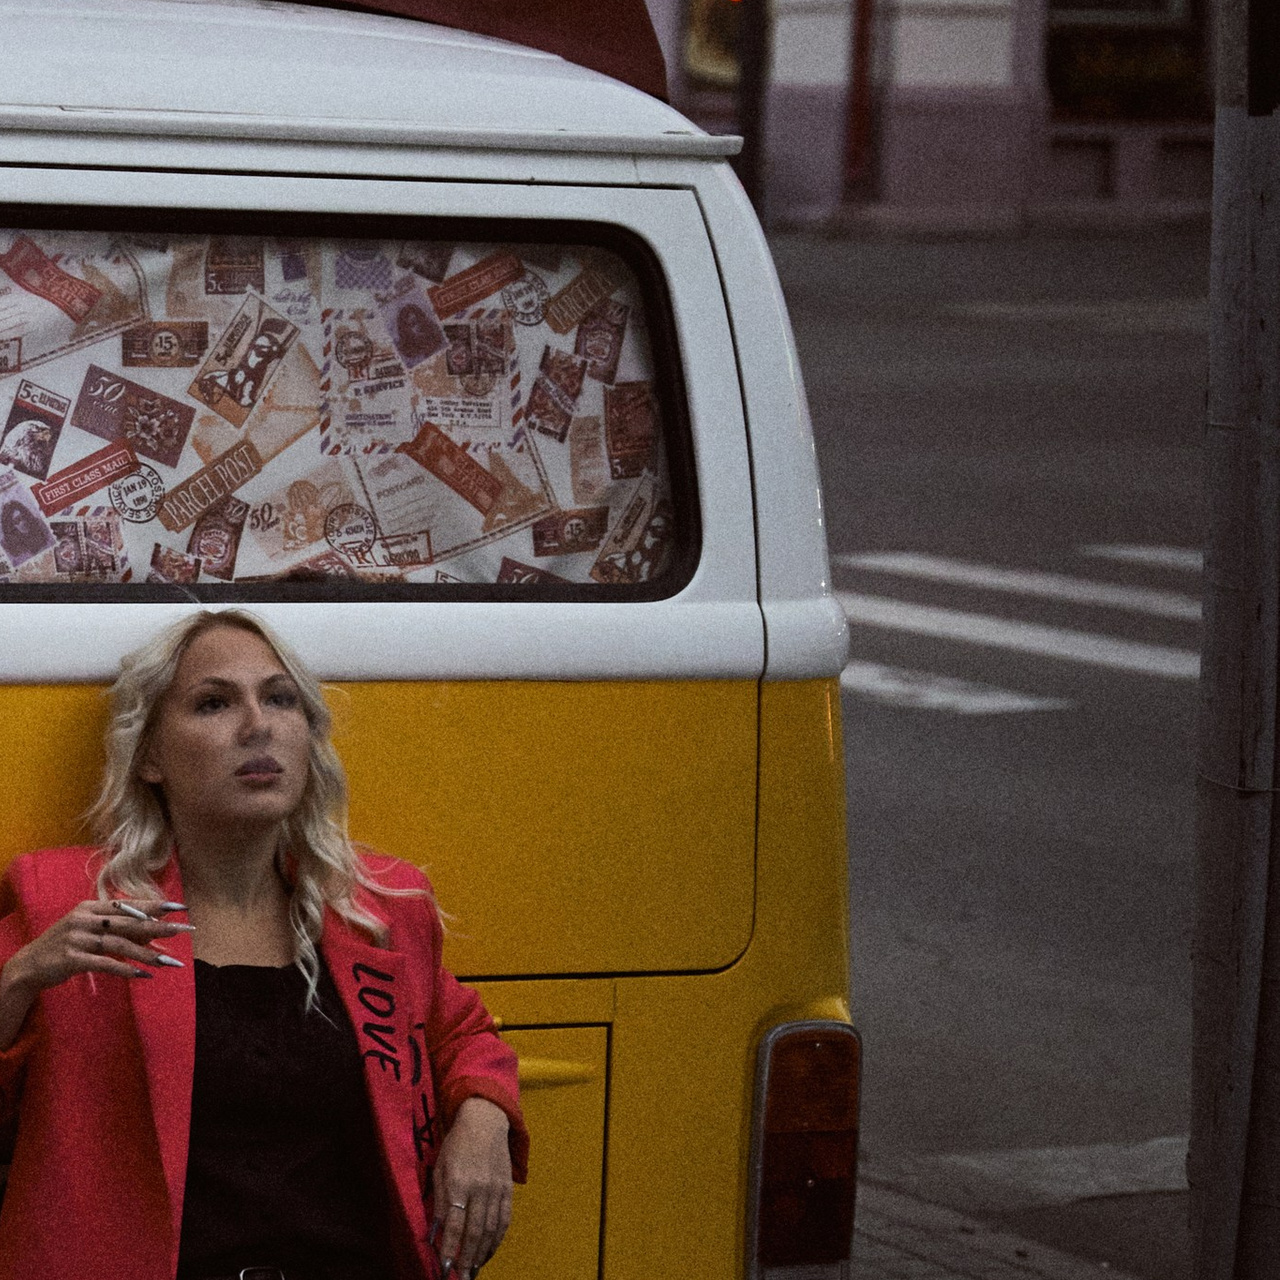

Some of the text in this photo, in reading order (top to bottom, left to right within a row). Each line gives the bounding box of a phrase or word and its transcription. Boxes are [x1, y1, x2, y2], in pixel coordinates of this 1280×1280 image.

[158, 336, 173, 351] 15
[19, 383, 39, 403] 5c
[88, 376, 126, 403] 50
[44, 457, 129, 502] FIRST CLASS MAIL
[163, 444, 257, 528] PARCEL POST
[376, 475, 426, 500] POSTCARD
[112, 483, 142, 519] SERVICE
[250, 502, 274, 531] 50
[352, 962, 401, 1082] LOVE
